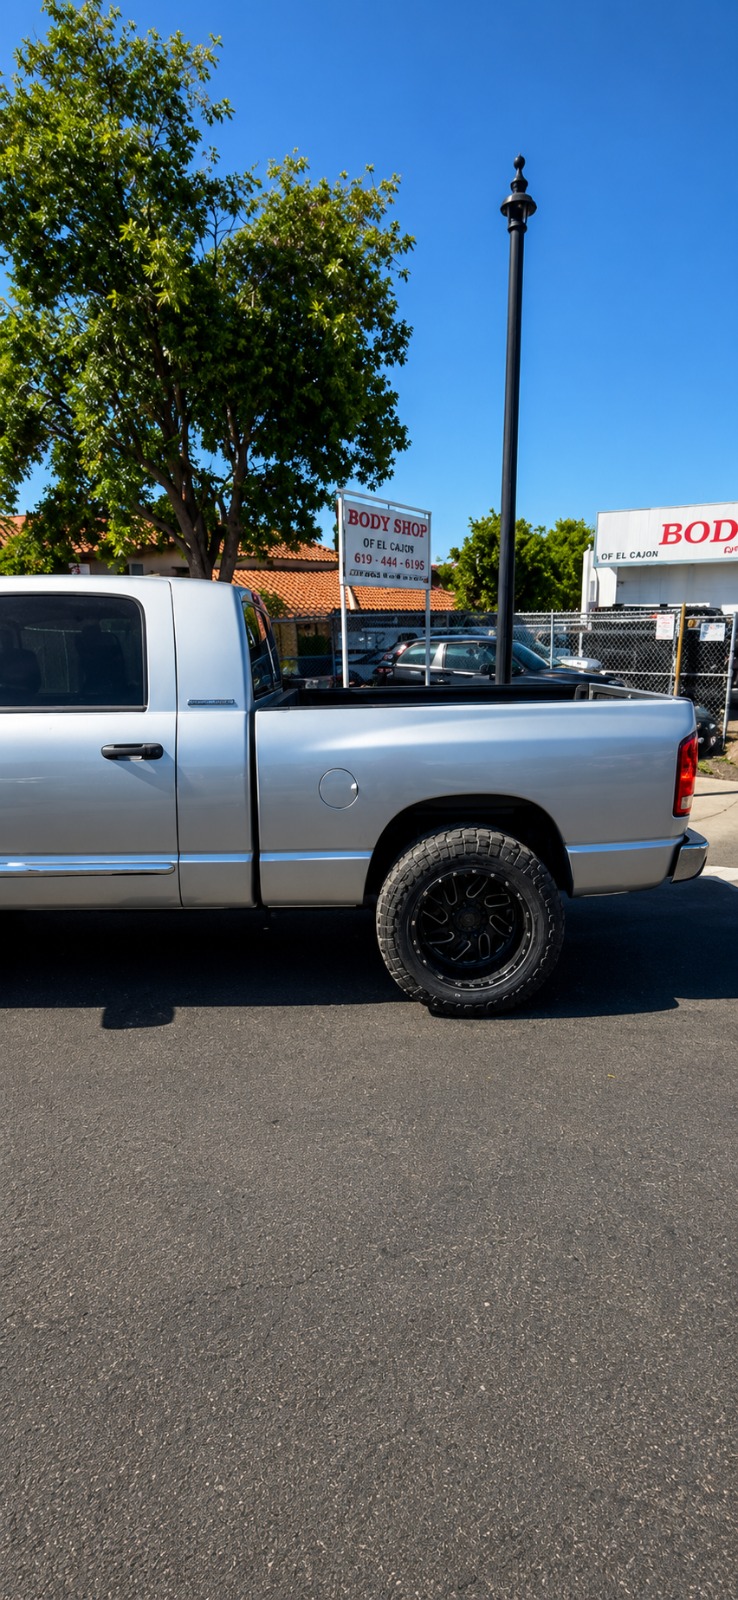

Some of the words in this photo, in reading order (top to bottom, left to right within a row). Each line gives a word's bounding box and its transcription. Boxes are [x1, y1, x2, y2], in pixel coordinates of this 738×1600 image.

[347, 509, 390, 532] BODY
[394, 519, 427, 538] SHOP
[658, 519, 738, 545] BOD
[363, 538, 375, 548] OF
[377, 540, 387, 550] EL
[354, 552, 372, 564] 619
[380, 556, 397, 568] 444
[601, 552, 614, 560] OF
[616, 552, 627, 560] EL
[629, 551, 659, 559] CAJON
